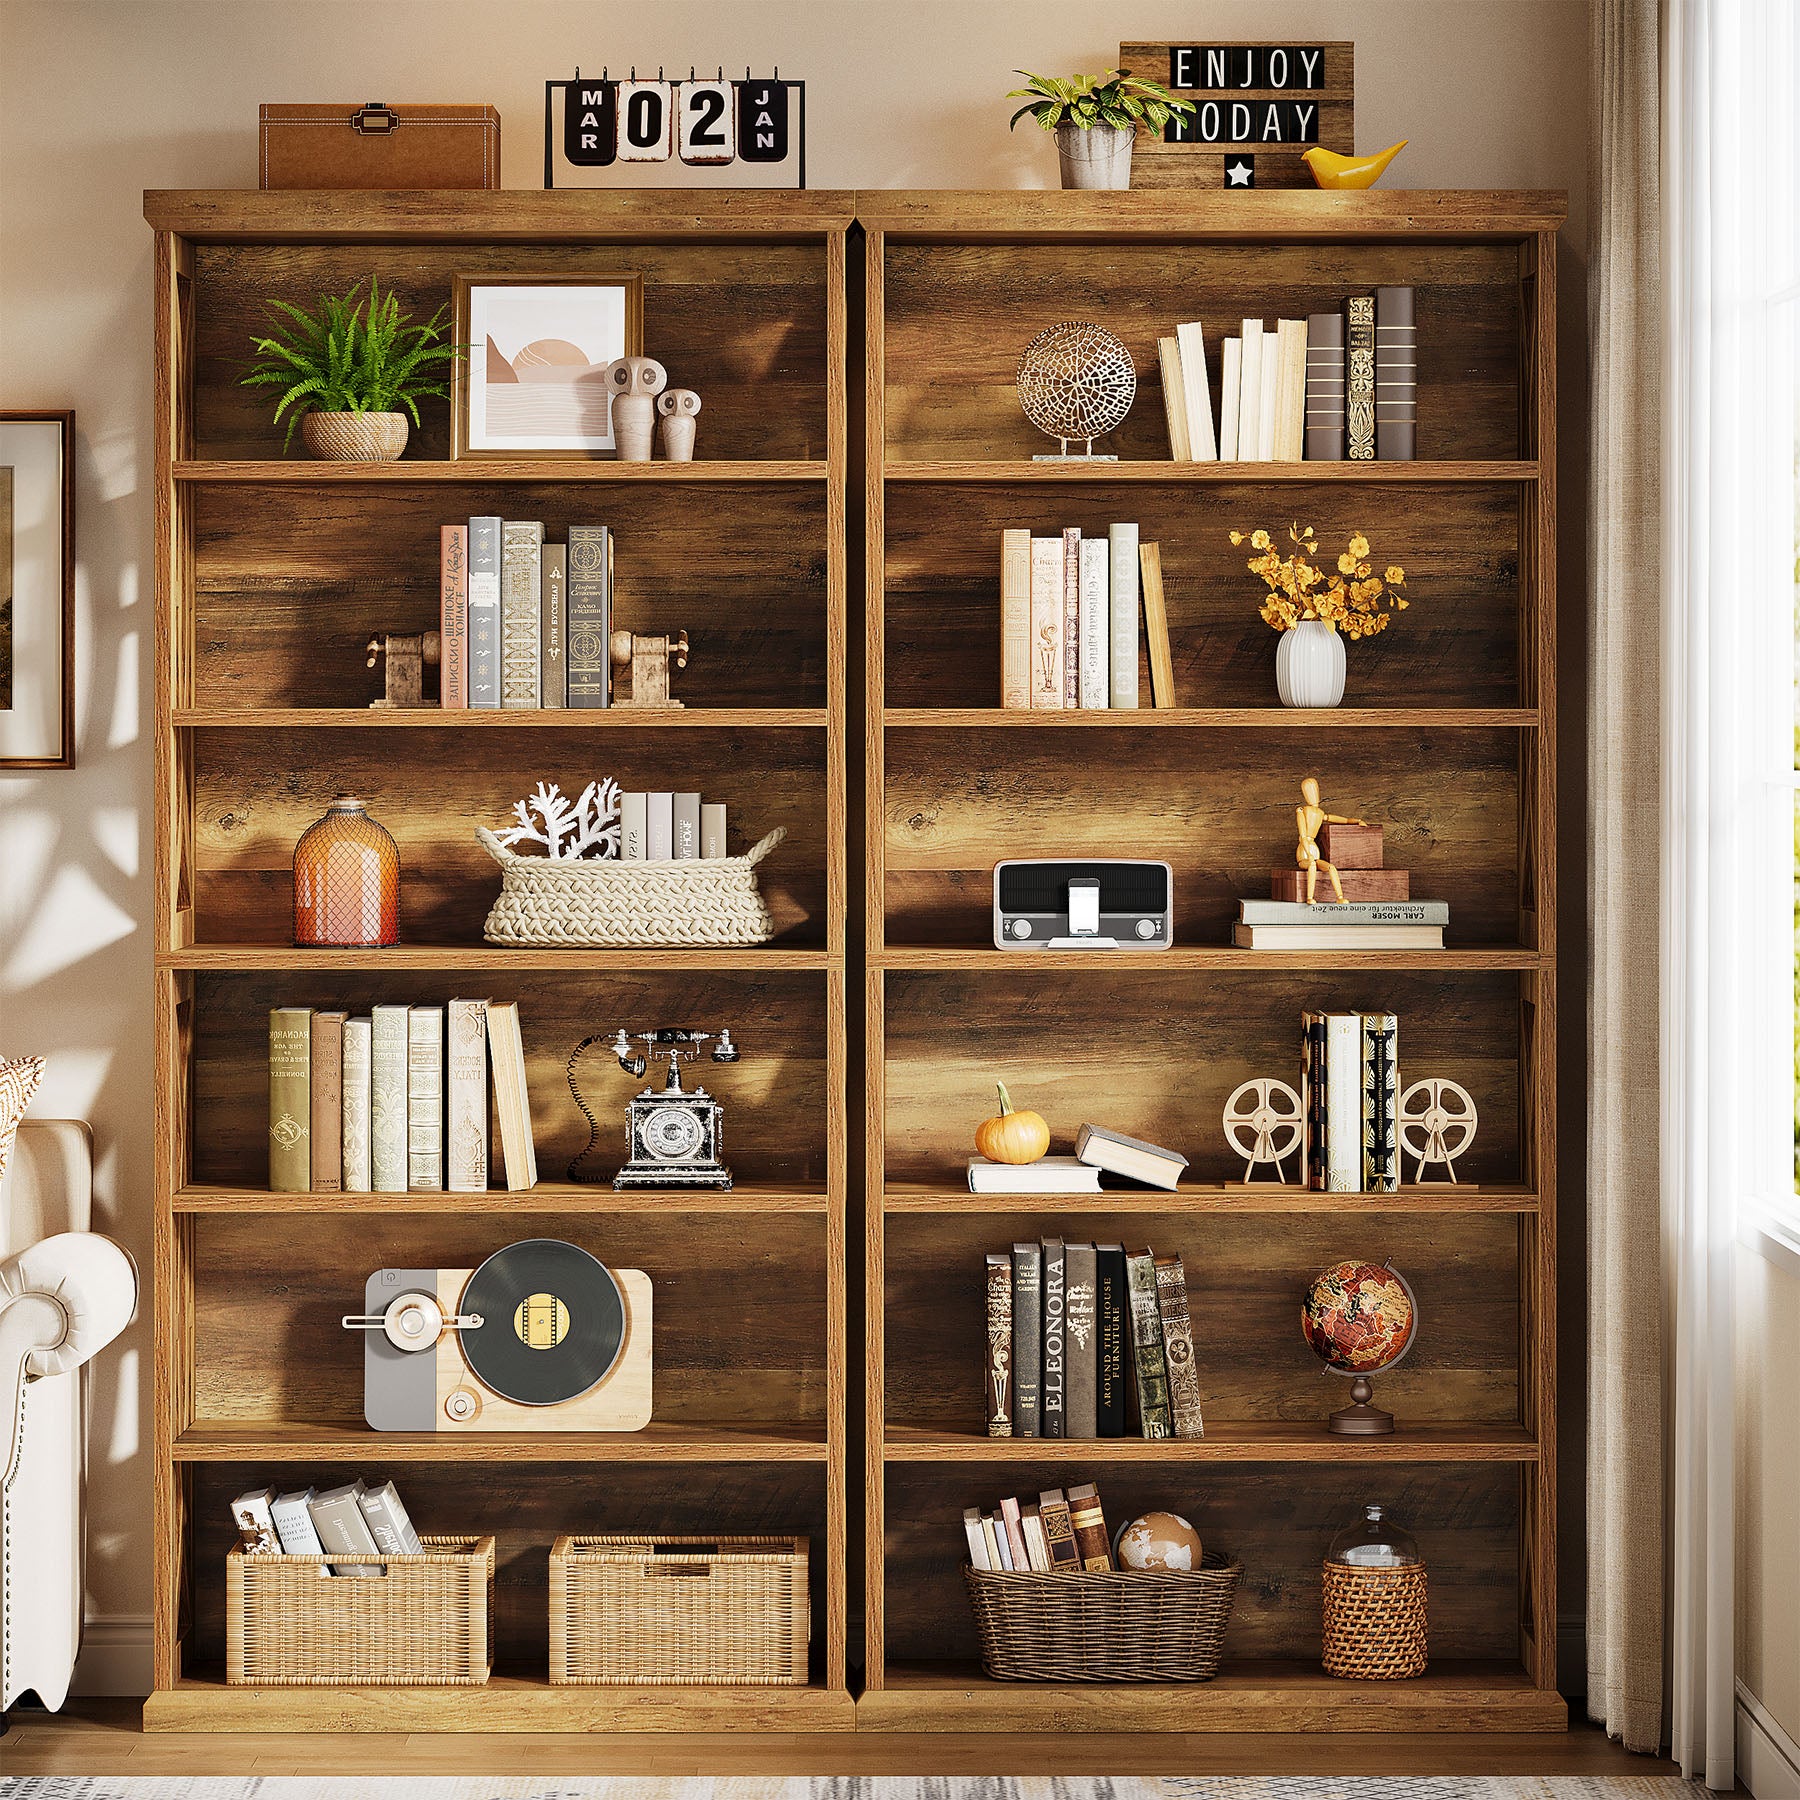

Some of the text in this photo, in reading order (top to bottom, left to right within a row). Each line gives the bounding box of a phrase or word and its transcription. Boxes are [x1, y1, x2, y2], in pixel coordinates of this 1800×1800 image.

[1177, 49, 1319, 89] ENJOY
[580, 90, 603, 149] MAR
[754, 90, 774, 149] JAN
[1171, 102, 1314, 141] TODAY
[444, 585, 455, 637] ШЕРЛОКЕ
[455, 591, 466, 637] ХОЛМСЕ
[551, 584, 559, 626] БУССЕНАР
[449, 648, 459, 701] ЗАПИСКИ
[1368, 905, 1380, 913] für
[1371, 912, 1425, 920] CARL MOSER
[1103, 1277, 1112, 1319] HOUSE
[1157, 1284, 1188, 1301] BURNS
[1045, 1258, 1064, 1413] ELEONORA
[1112, 1306, 1120, 1378] FURNITURE
[1103, 1354, 1112, 1408] AROUND
